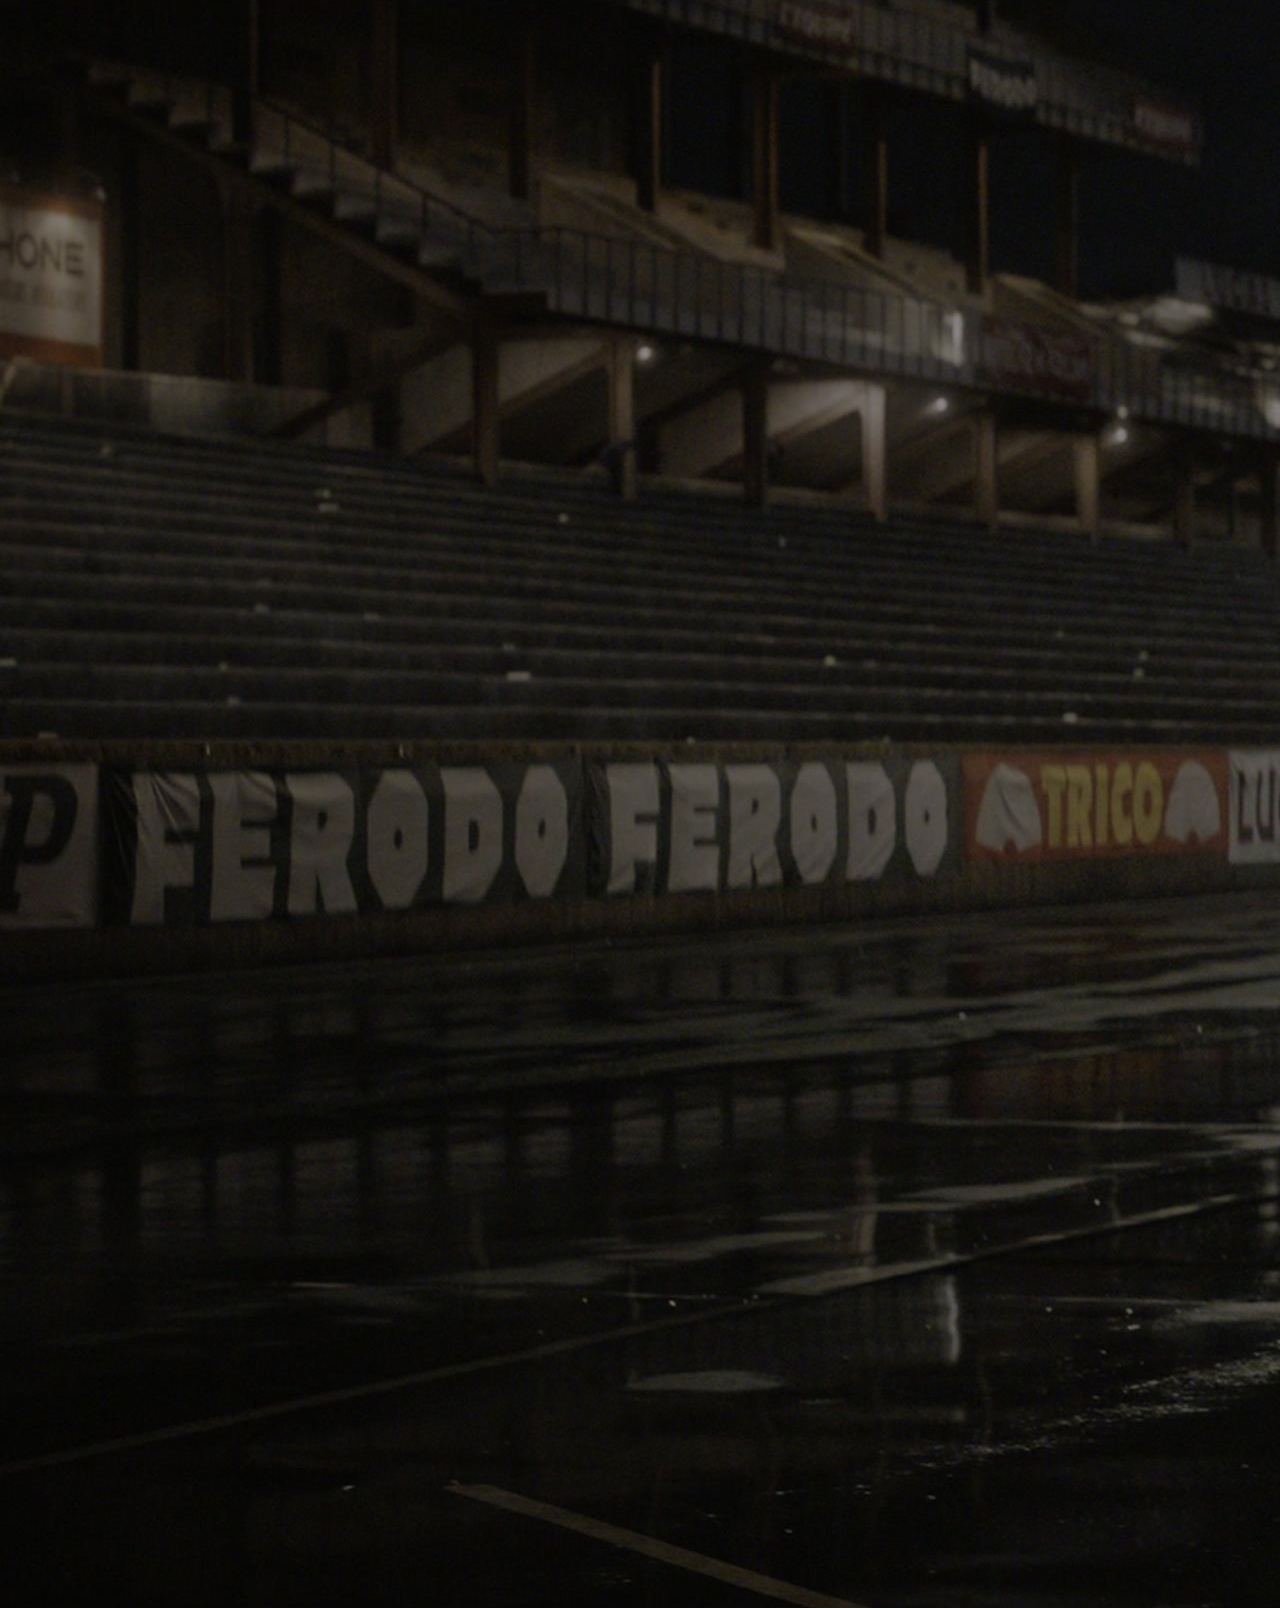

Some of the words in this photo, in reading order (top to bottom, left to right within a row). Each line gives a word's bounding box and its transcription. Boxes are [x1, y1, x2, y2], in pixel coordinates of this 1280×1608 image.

[130, 763, 569, 926] FERODO
[605, 757, 948, 895] FERODO
[1041, 759, 1163, 849] TRICO
